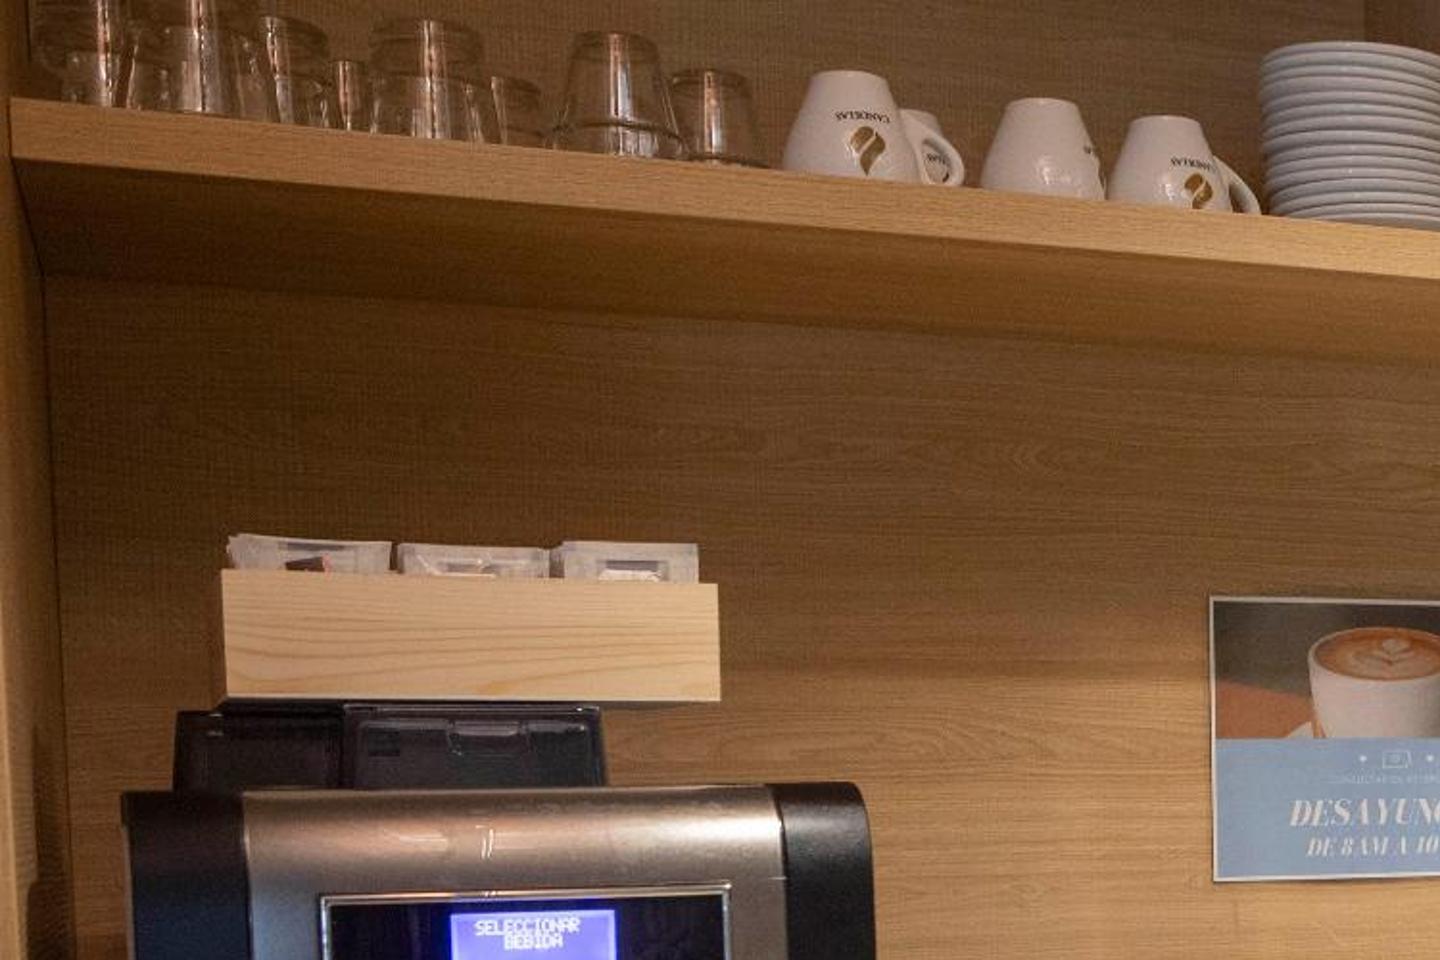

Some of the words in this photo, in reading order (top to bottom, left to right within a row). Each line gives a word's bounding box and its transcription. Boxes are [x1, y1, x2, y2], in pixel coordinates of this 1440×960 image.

[1306, 836, 1336, 857] DE
[1358, 836, 1389, 856] AM
[1416, 834, 1440, 854] 10
[474, 917, 582, 936] SELECCIONAR
[503, 933, 564, 951] BEBIDA
